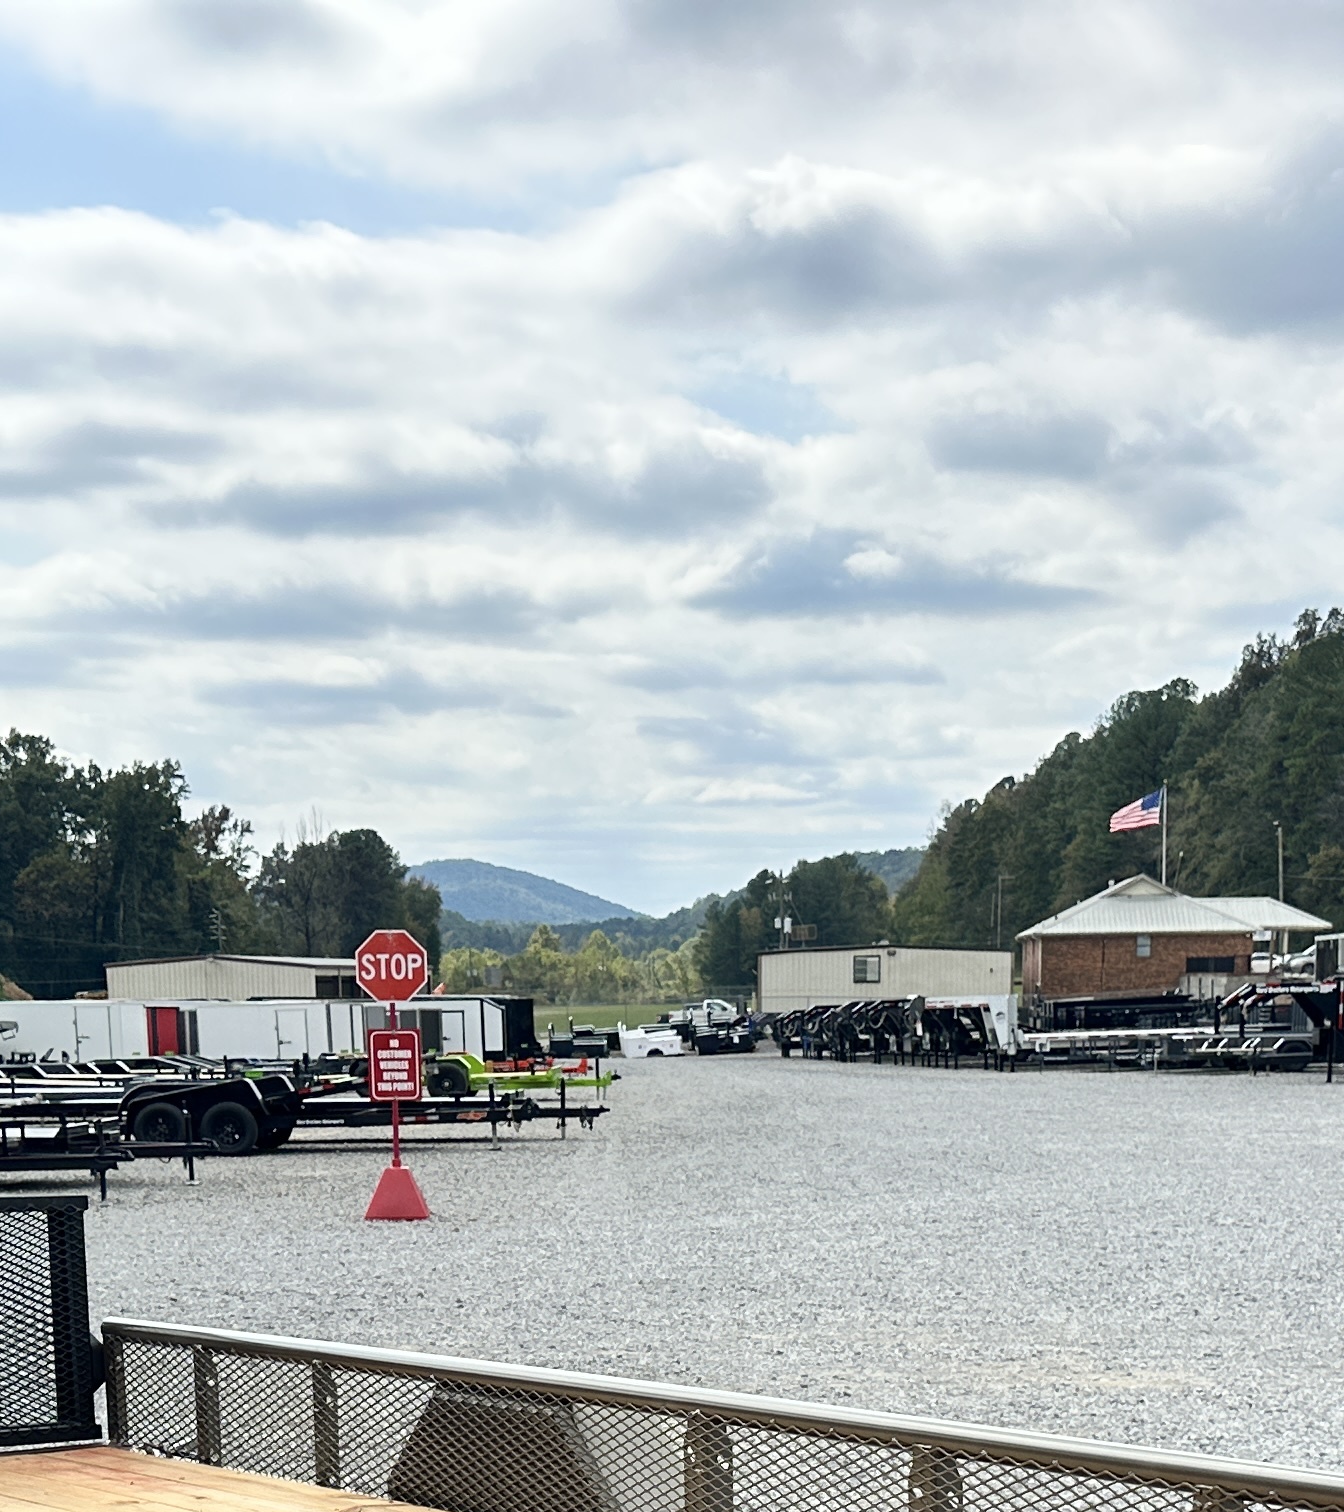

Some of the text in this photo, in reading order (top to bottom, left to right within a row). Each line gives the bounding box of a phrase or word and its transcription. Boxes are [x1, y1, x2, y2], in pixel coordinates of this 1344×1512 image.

[360, 952, 423, 981] STOP
[389, 1038, 399, 1048] NO
[377, 1081, 393, 1092] THIS
